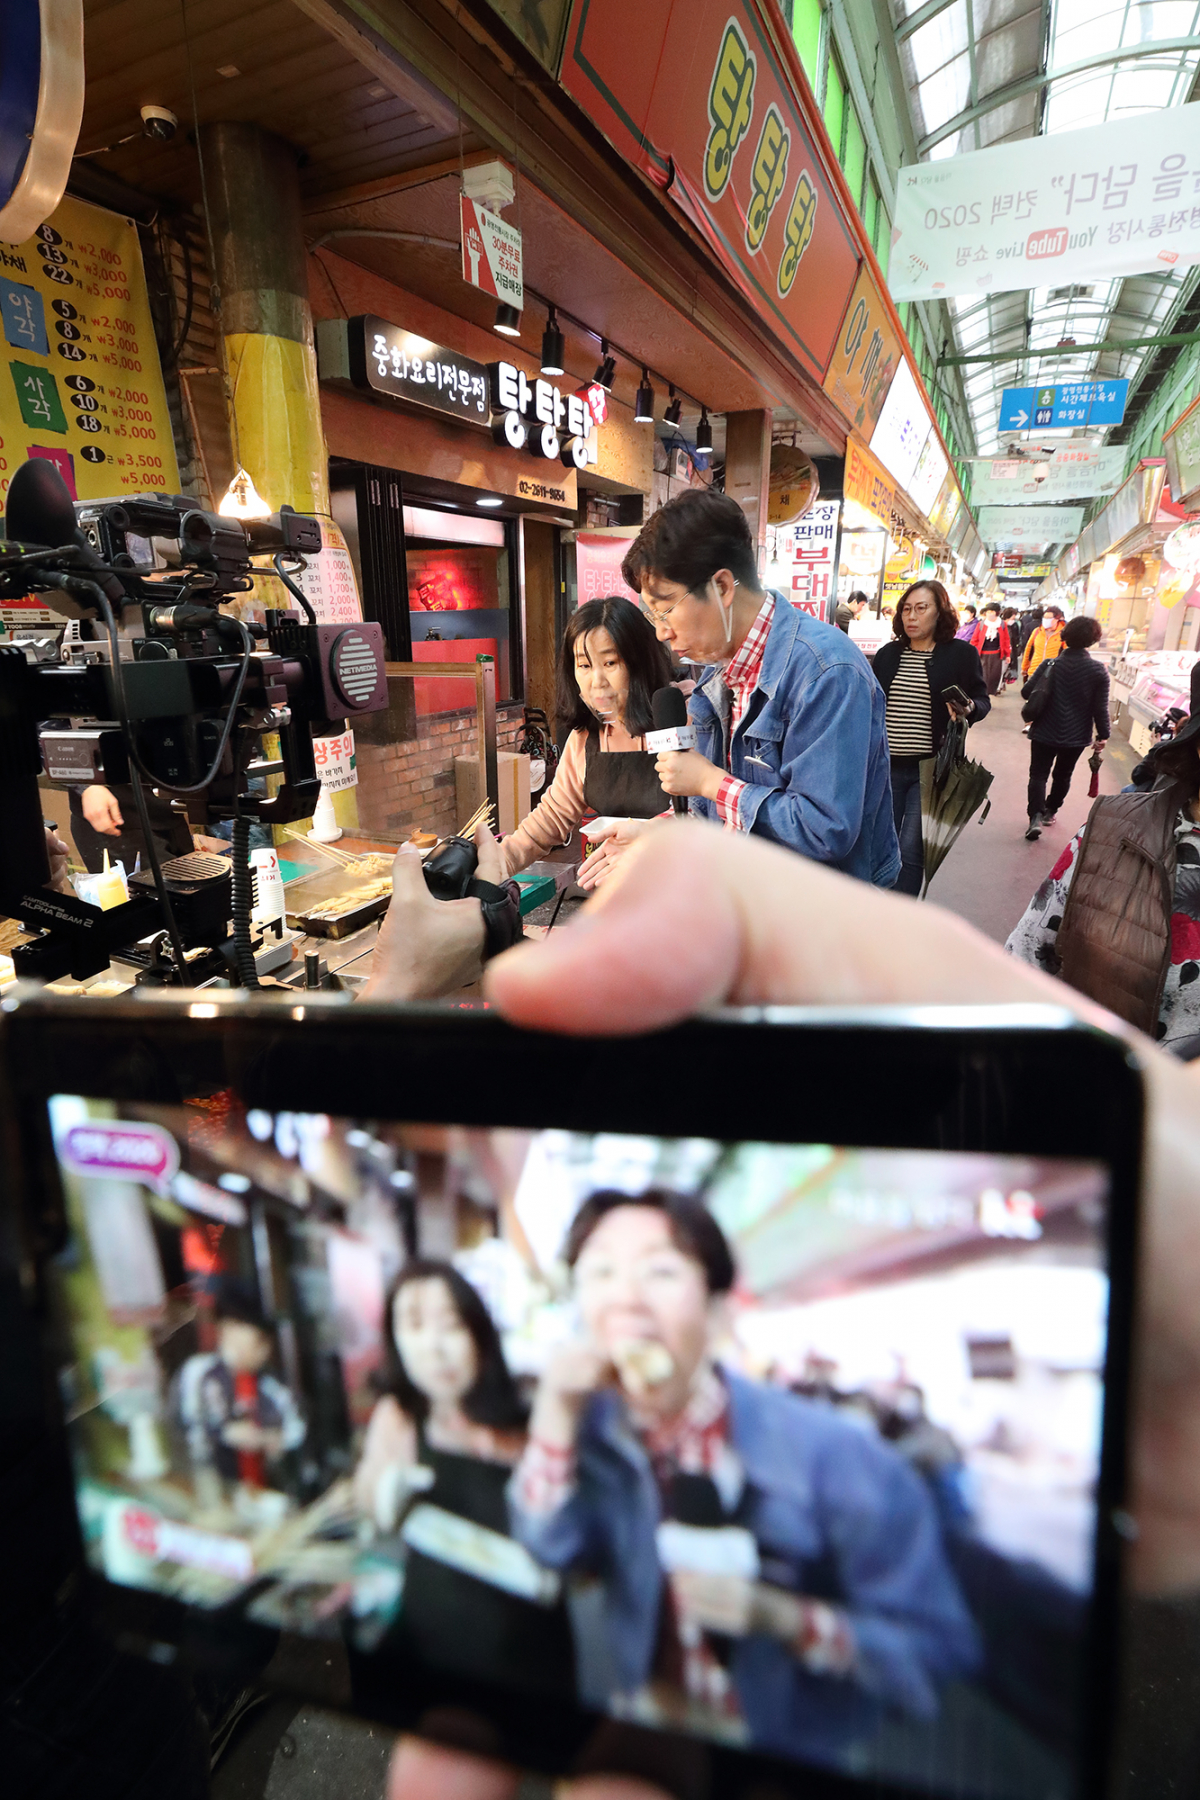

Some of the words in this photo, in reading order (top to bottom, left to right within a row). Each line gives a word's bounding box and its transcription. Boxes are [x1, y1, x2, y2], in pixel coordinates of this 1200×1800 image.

[705, 18, 815, 297] 탕탕탕
[42, 225, 54, 242] 8
[65, 240, 74, 250] 개
[42, 244, 63, 263] 13
[70, 259, 79, 269] 개
[498, 255, 519, 279] 주차권
[48, 265, 70, 284] 22
[76, 279, 83, 289] 개
[61, 301, 70, 317] 5
[80, 314, 87, 324] 개
[63, 322, 73, 338] 8
[83, 334, 92, 343] 개
[62, 343, 82, 360] 14
[89, 353, 98, 362] 개
[844, 297, 884, 398] 야채
[372, 334, 486, 412] 중화요리전문점
[75, 376, 87, 390] 6
[97, 385, 105, 394] 개
[1061, 384, 1105, 395] 광명전통시장
[77, 394, 95, 411] 10
[100, 404, 107, 414] 개
[1060, 391, 1116, 405] 시간제보육실
[81, 415, 99, 432] 18
[103, 425, 110, 434] 개
[499, 361, 594, 469] 탕탕탕
[1058, 409, 1085, 420] 화장실
[90, 447, 98, 462] 1
[106, 454, 114, 465] 근
[794, 525, 833, 540] 판매
[339, 664, 377, 676] NETMEDIA
[313, 735, 353, 765] 상주의
[20, 900, 54, 916] ALPHA
[55, 911, 83, 925] BEAM
[83, 917, 94, 928] 2
